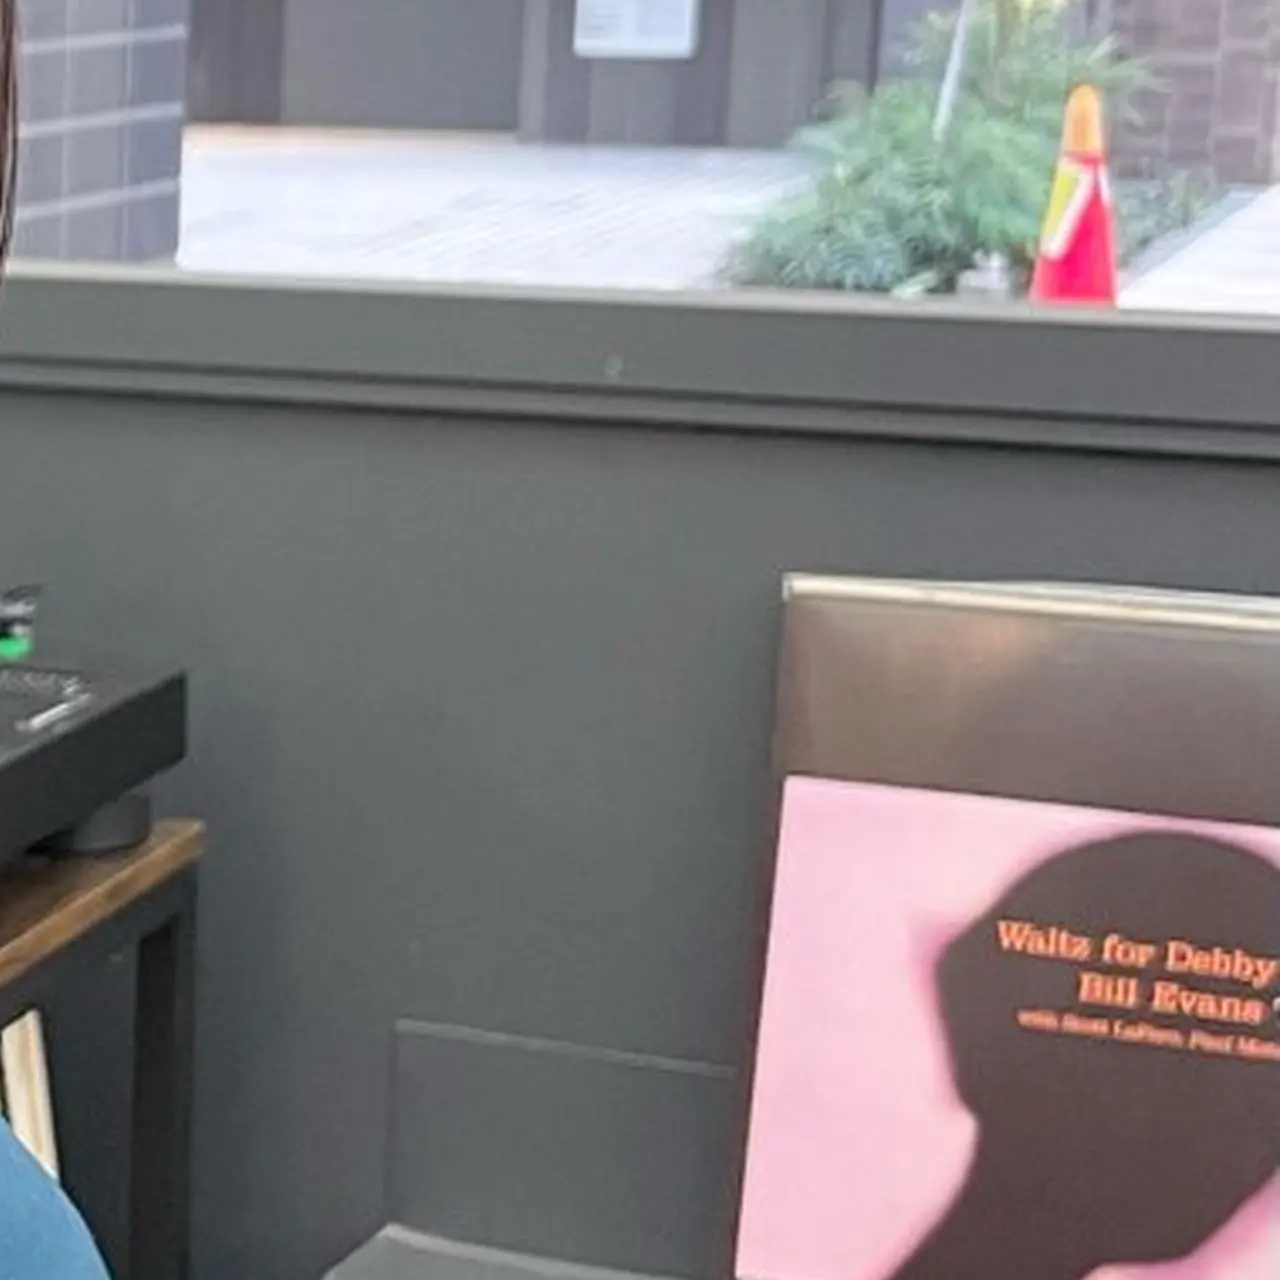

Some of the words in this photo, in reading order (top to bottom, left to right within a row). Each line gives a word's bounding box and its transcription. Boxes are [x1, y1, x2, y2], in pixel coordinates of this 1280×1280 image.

[996, 919, 1091, 960] Waltz
[1102, 932, 1155, 968] for
[1165, 939, 1277, 989] Debby
[1078, 971, 1138, 1008] Bill
[1151, 980, 1268, 1024] Evans
